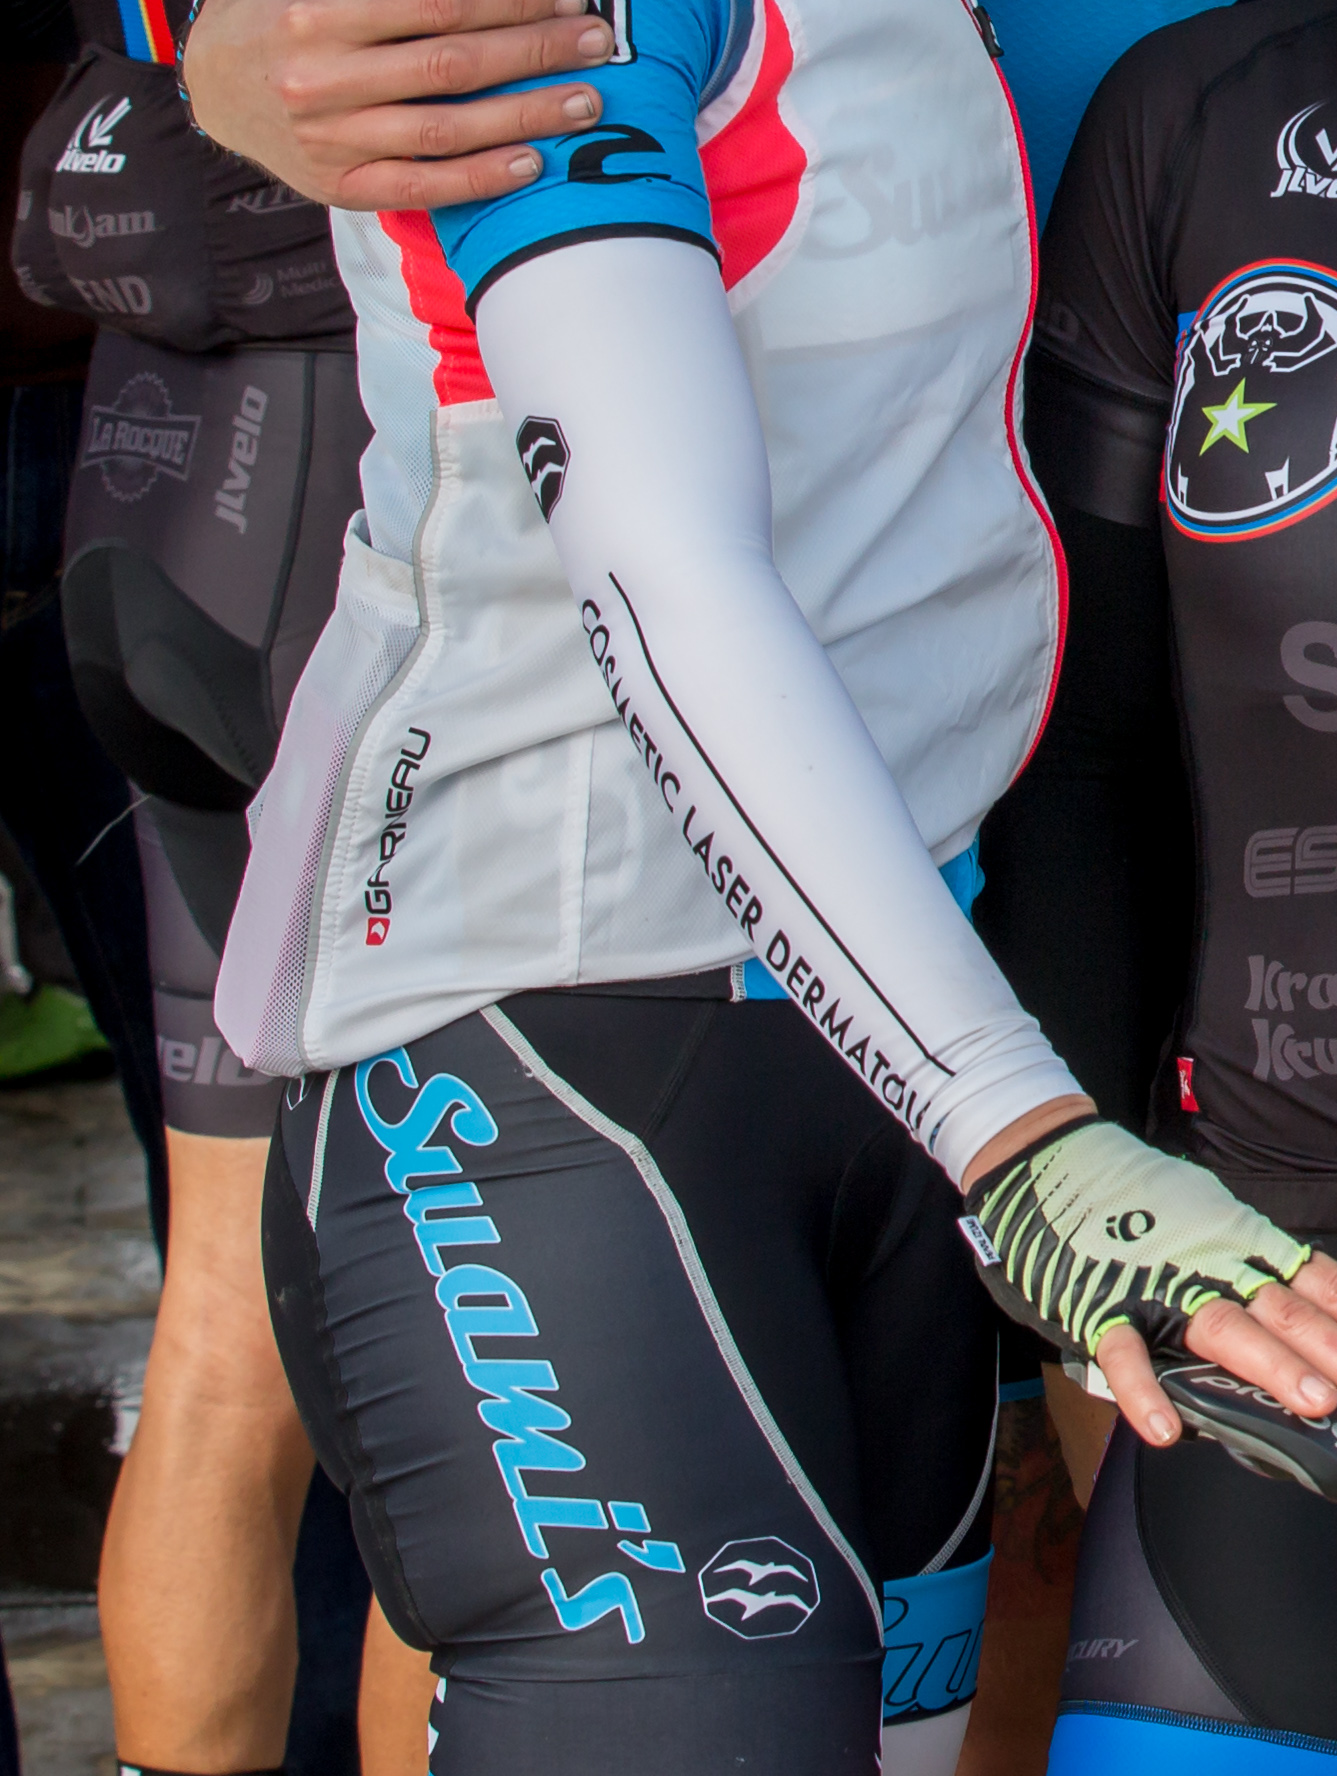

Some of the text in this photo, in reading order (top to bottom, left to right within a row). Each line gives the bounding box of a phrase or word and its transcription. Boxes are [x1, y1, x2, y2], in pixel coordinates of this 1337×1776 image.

[365, 726, 431, 916] GARNEAU
[581, 598, 682, 812] COSMETIC
[681, 804, 763, 949] LASER
[353, 1045, 687, 1644] Swami's
